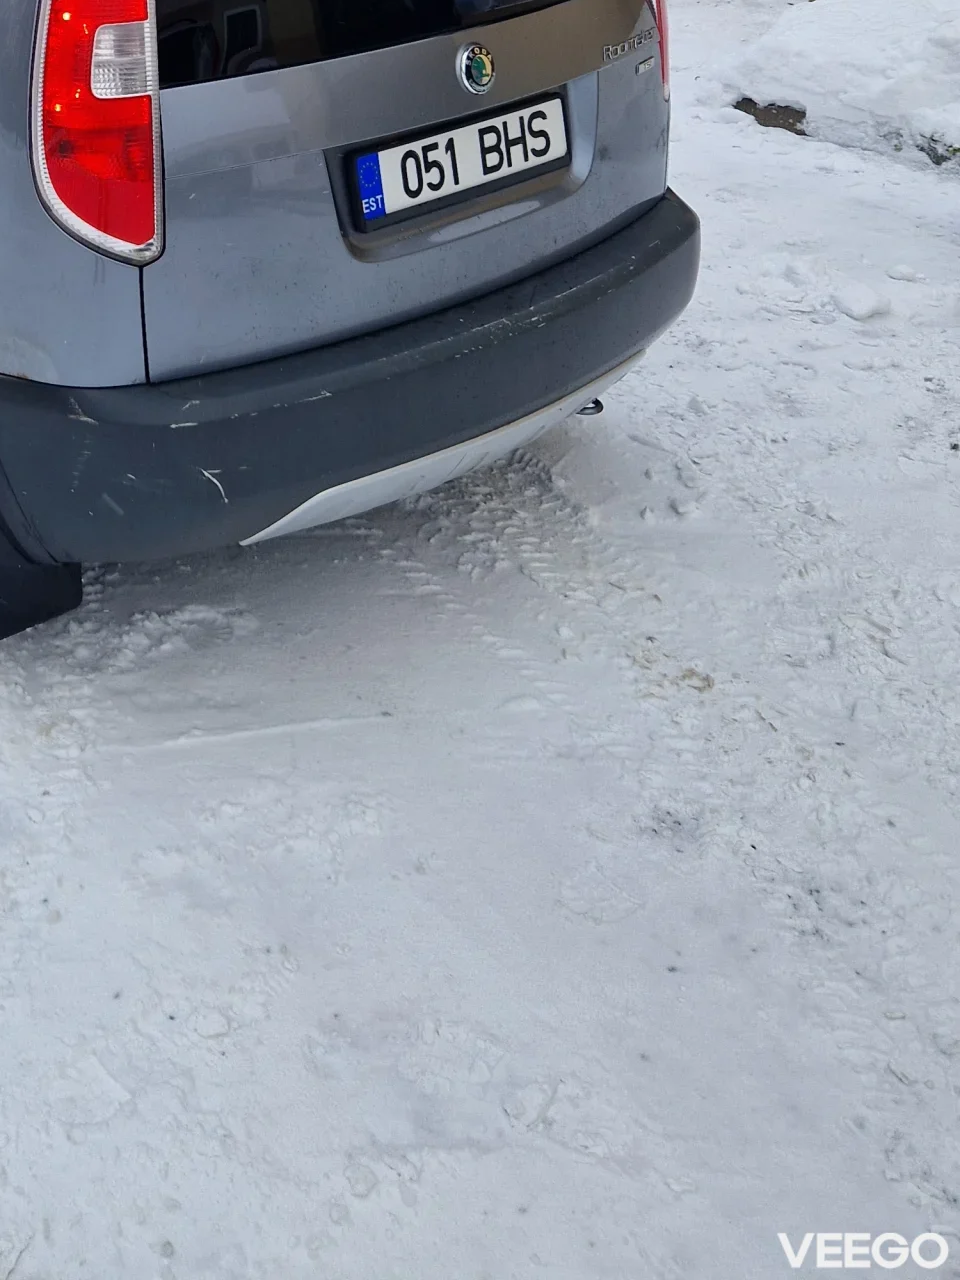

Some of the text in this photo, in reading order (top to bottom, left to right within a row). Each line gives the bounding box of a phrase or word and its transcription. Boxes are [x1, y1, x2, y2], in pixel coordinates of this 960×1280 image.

[400, 110, 551, 199] 051 BHS
[362, 194, 383, 214] EST
